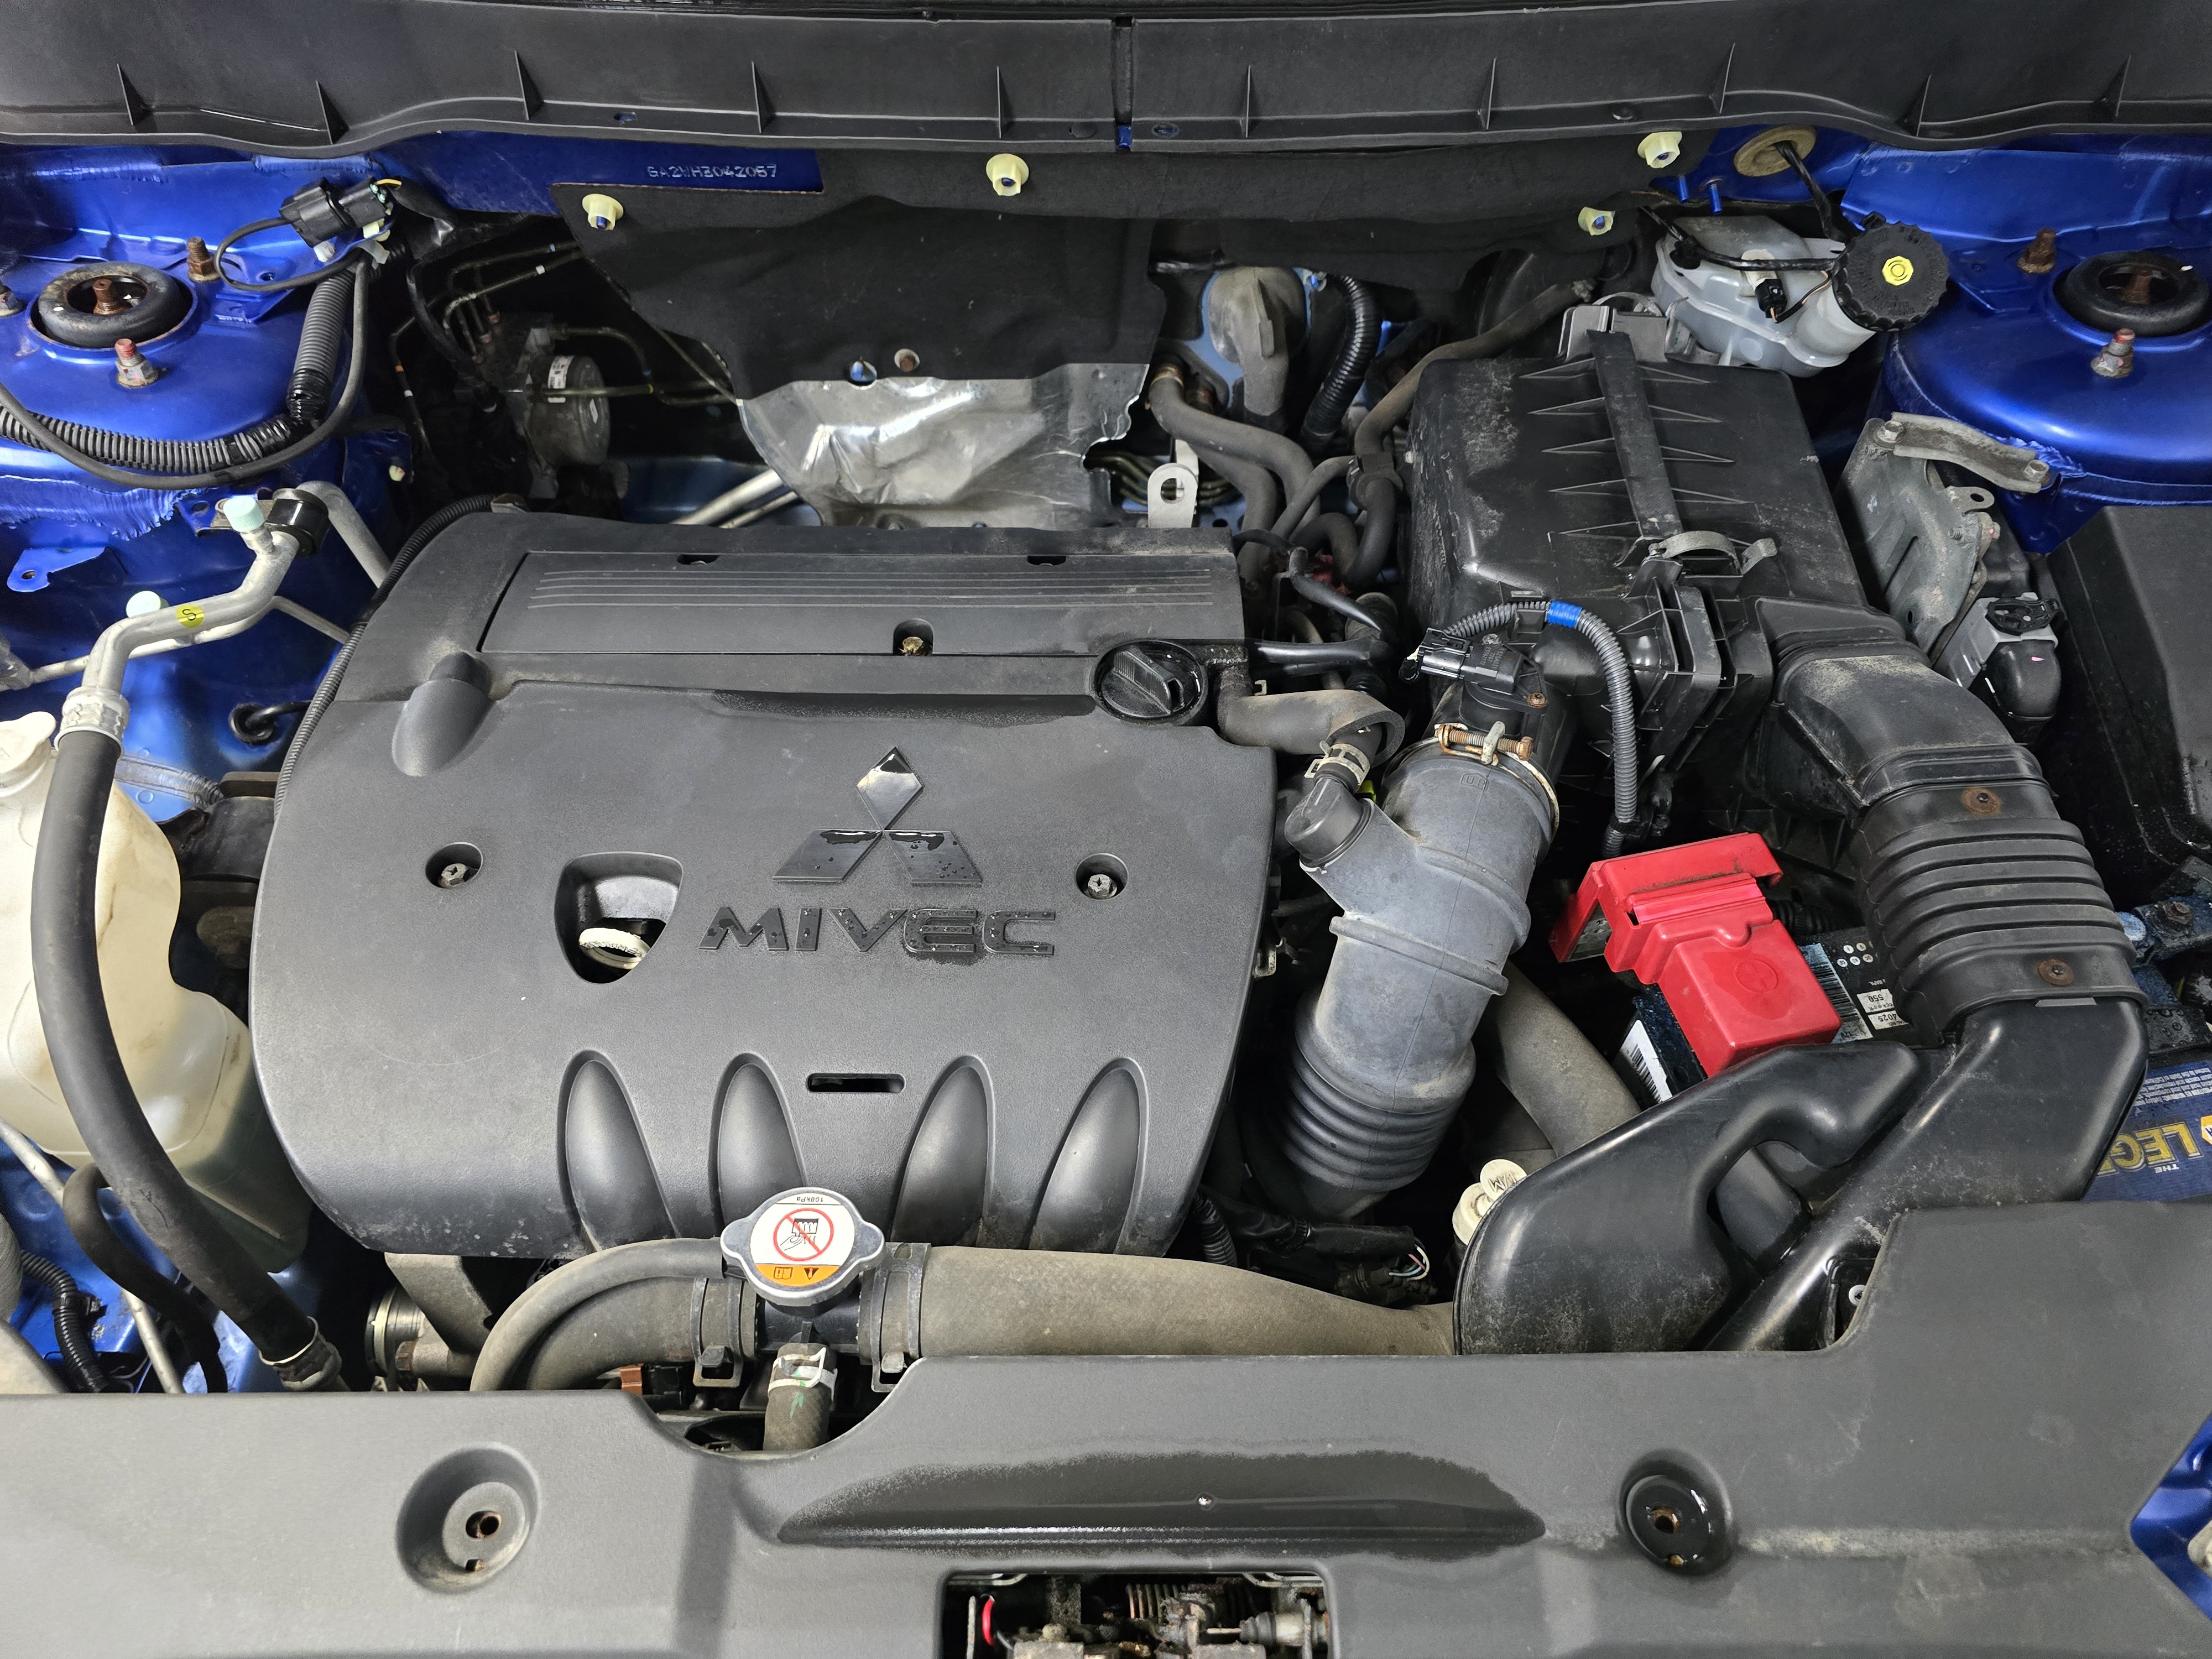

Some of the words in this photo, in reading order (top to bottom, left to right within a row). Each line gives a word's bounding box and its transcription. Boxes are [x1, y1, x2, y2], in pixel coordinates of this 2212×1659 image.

[182, 608, 196, 621] S
[1466, 774, 1486, 786] UP
[697, 906, 1056, 955] MIVEC
[1868, 994, 1884, 1003] 550
[1878, 1014, 1897, 1022] 4025
[2155, 1164, 2179, 1173] THE
